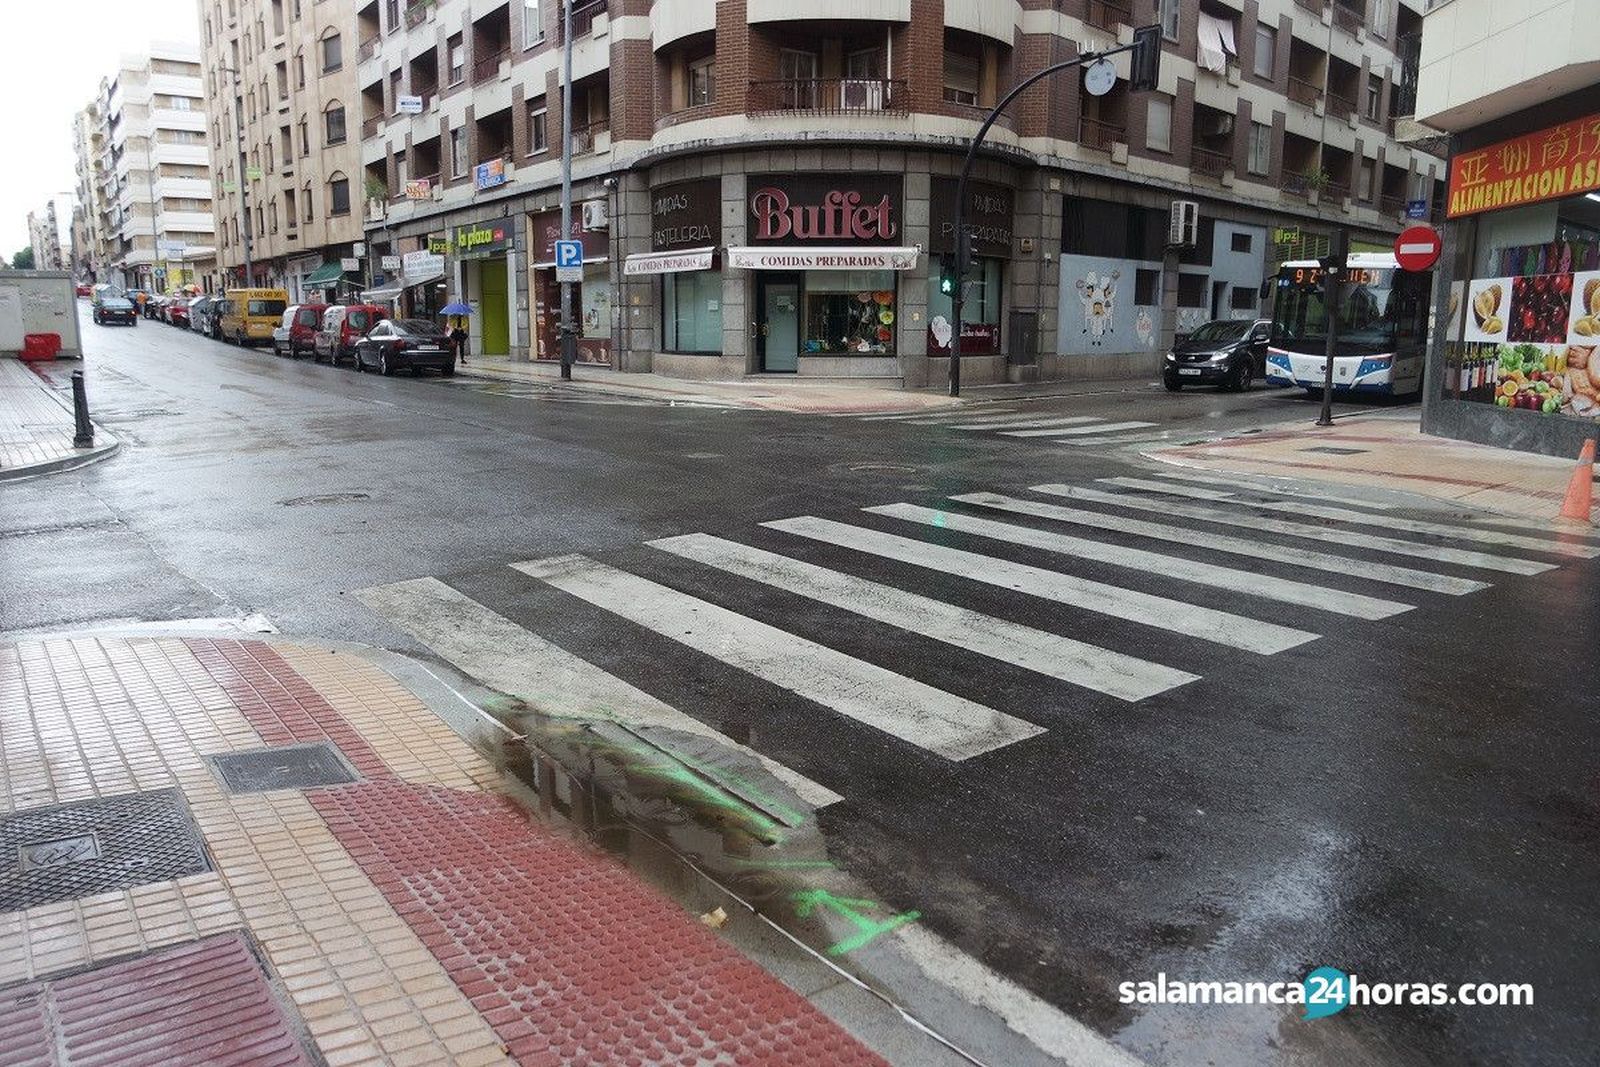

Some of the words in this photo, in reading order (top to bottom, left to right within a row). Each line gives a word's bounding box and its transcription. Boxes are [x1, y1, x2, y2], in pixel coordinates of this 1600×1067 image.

[1451, 165, 1567, 214] ALIMENTACION
[752, 187, 897, 240] Buffet
[467, 224, 493, 251] plaza
[561, 244, 577, 266] P
[760, 255, 813, 267] COMIDAS
[815, 255, 886, 267] PREPARADAS
